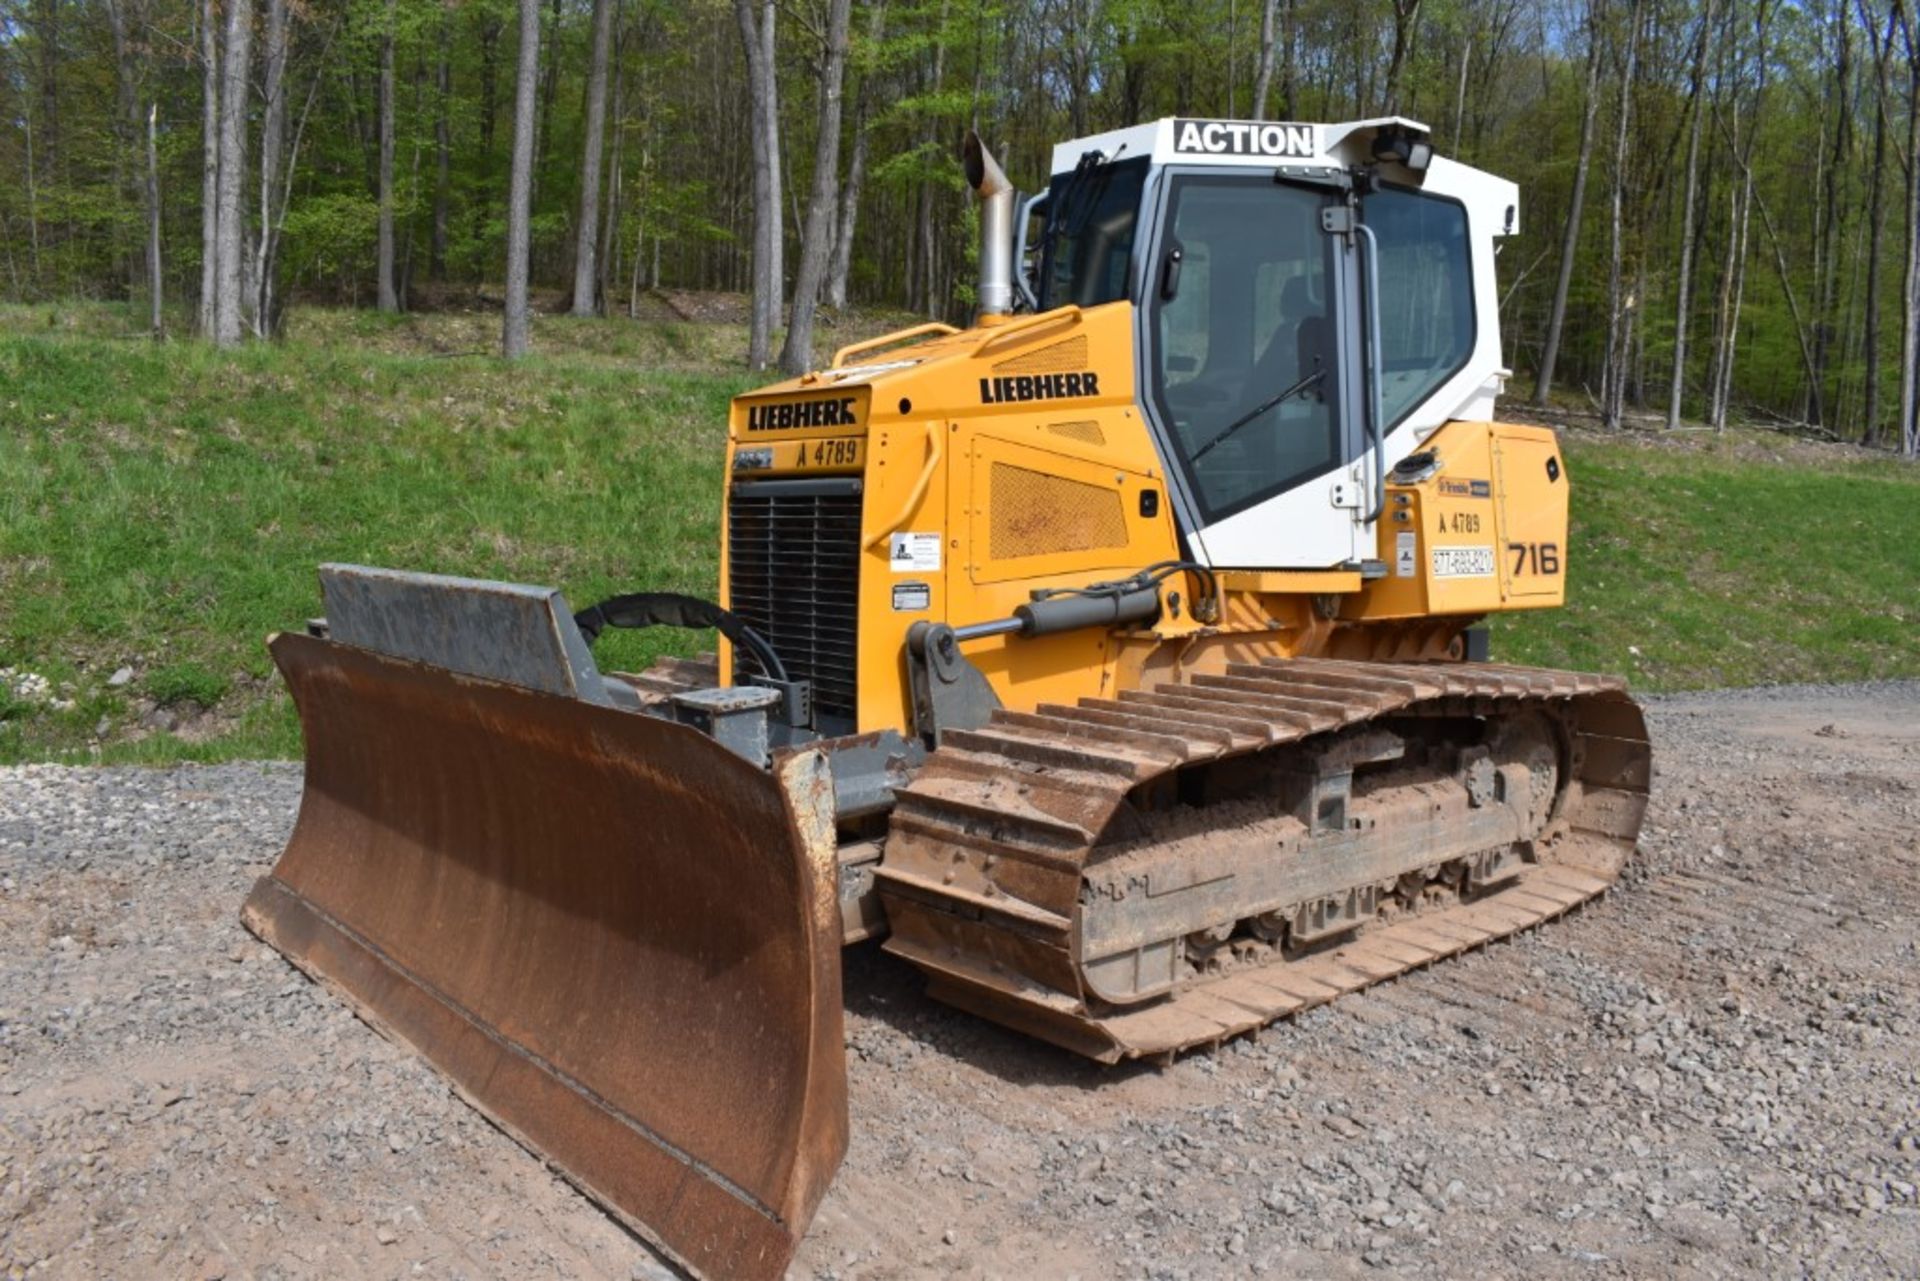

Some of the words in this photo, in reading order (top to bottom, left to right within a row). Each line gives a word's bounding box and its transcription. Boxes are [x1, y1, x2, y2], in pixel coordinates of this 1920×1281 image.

[1178, 122, 1312, 155] ACTION
[980, 373, 1100, 404] LIEBHERR
[748, 397, 857, 431] LIEBHERR
[796, 442, 806, 467] A
[815, 439, 857, 466] 4789
[1439, 513, 1446, 533] A
[1451, 513, 1480, 534] 4789
[1508, 543, 1559, 577] 716
